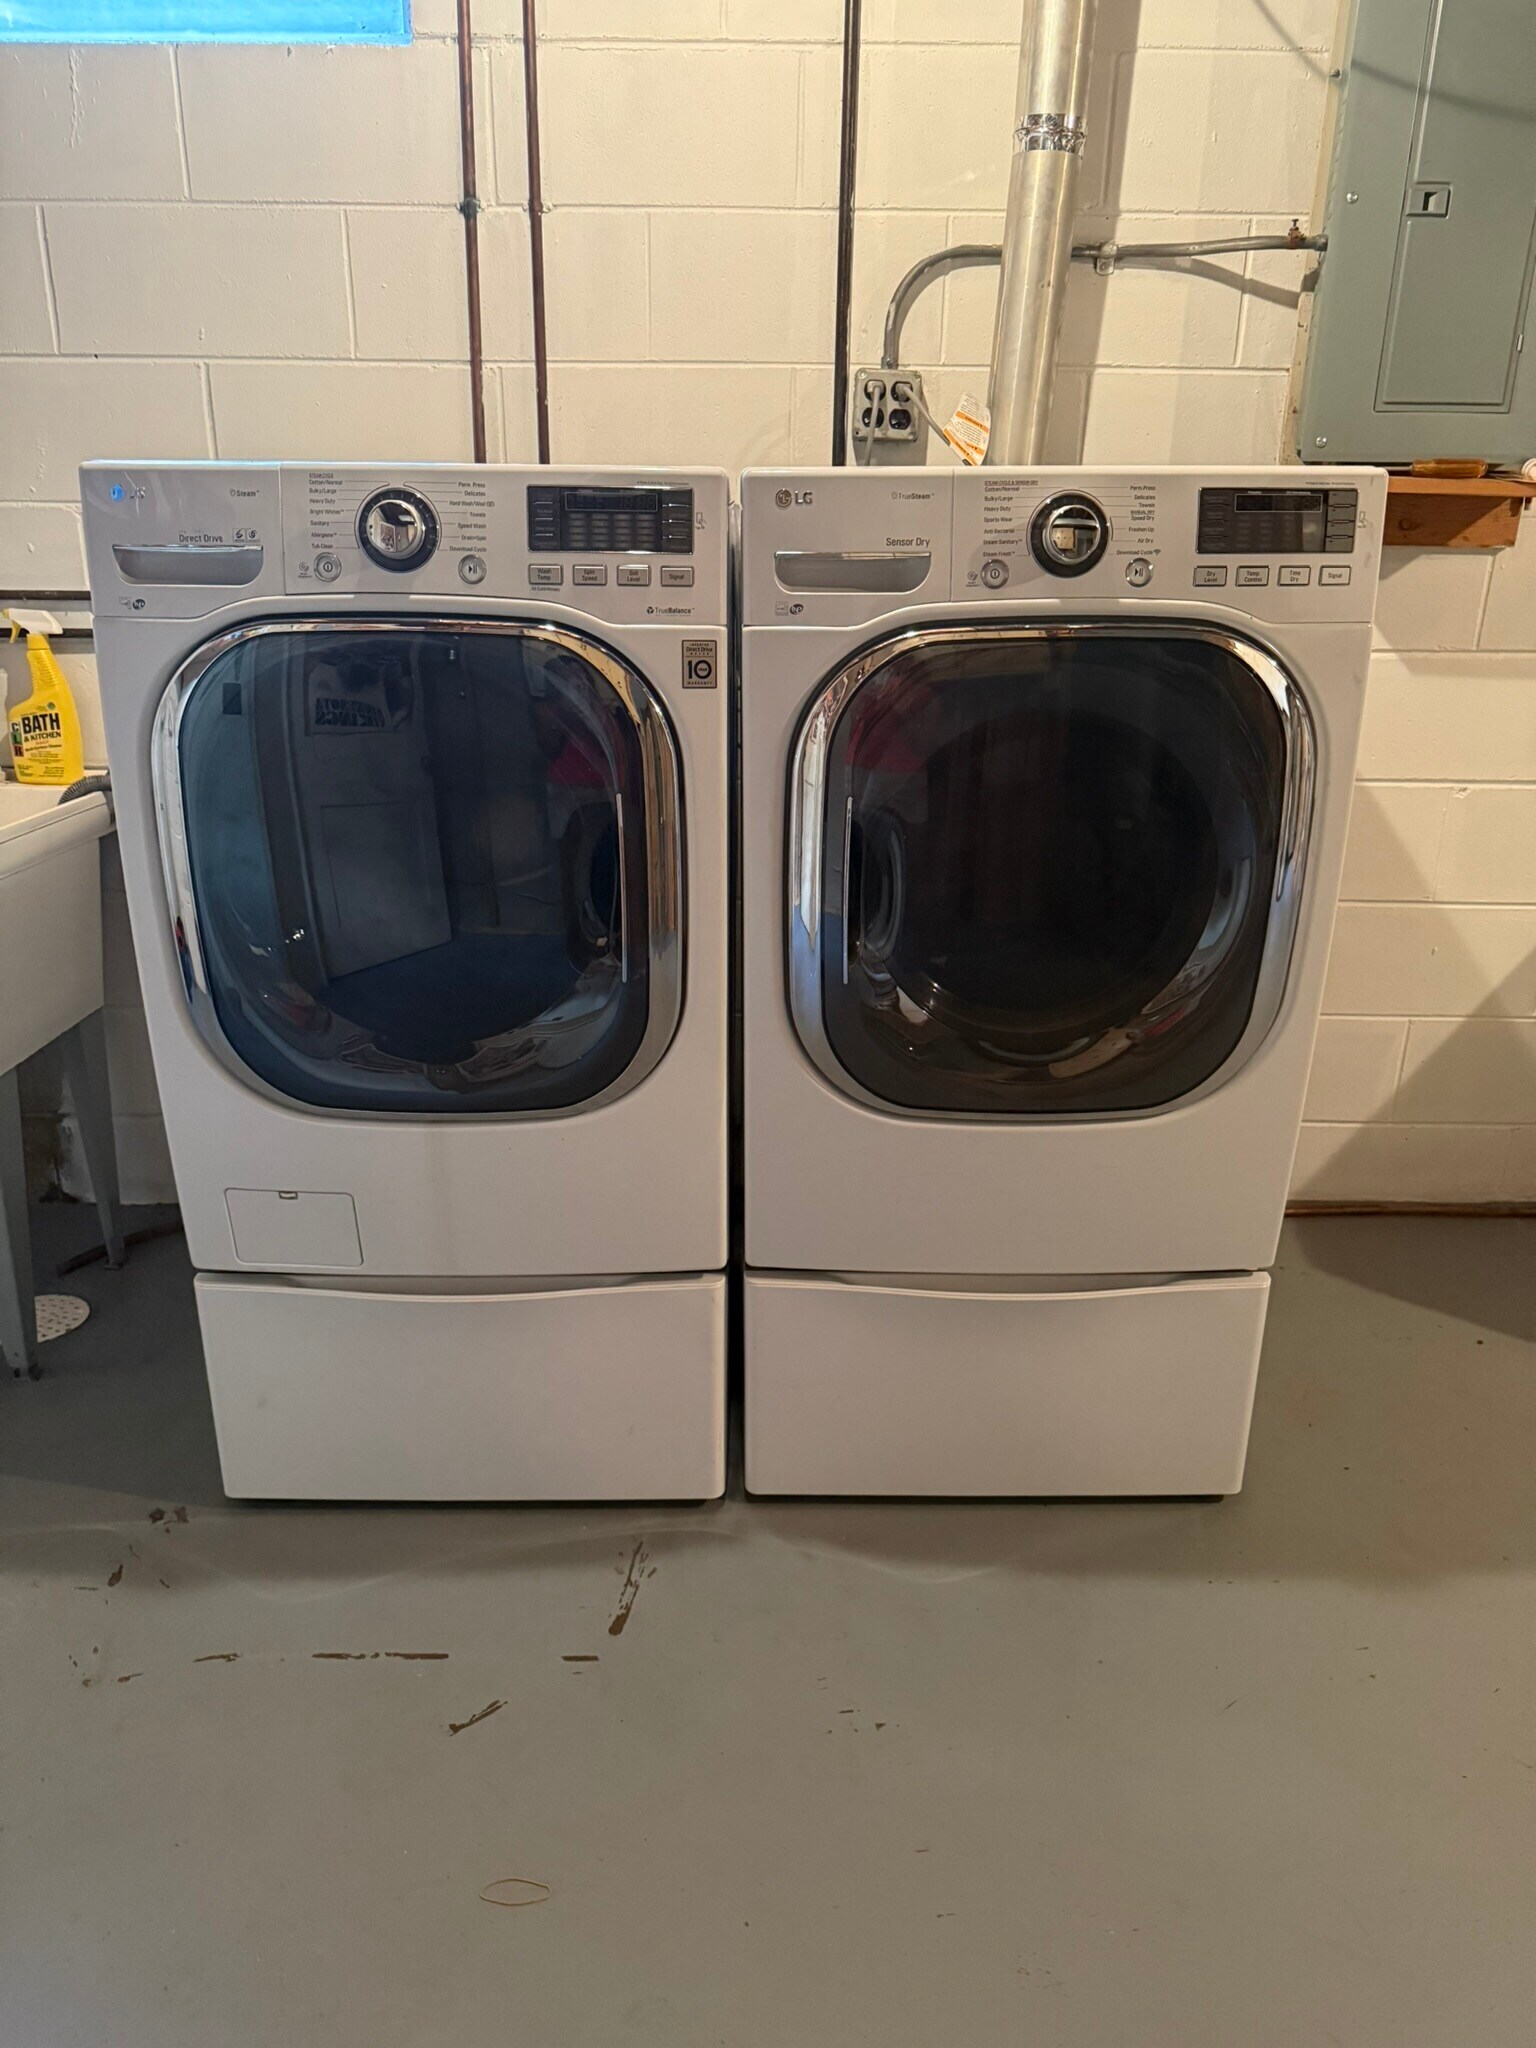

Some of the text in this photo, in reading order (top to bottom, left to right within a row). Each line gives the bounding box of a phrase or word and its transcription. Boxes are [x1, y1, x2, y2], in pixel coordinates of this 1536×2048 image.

[795, 491, 813, 504] LG
[457, 522, 473, 530] Speed
[179, 533, 202, 543] Direct
[203, 533, 224, 543] Drive
[886, 537, 930, 548] Sensor Dry
[669, 573, 684, 581] Signal
[687, 660, 712, 680] 10
[21, 712, 61, 735] BATH
[30, 731, 61, 741] KITCHEN
